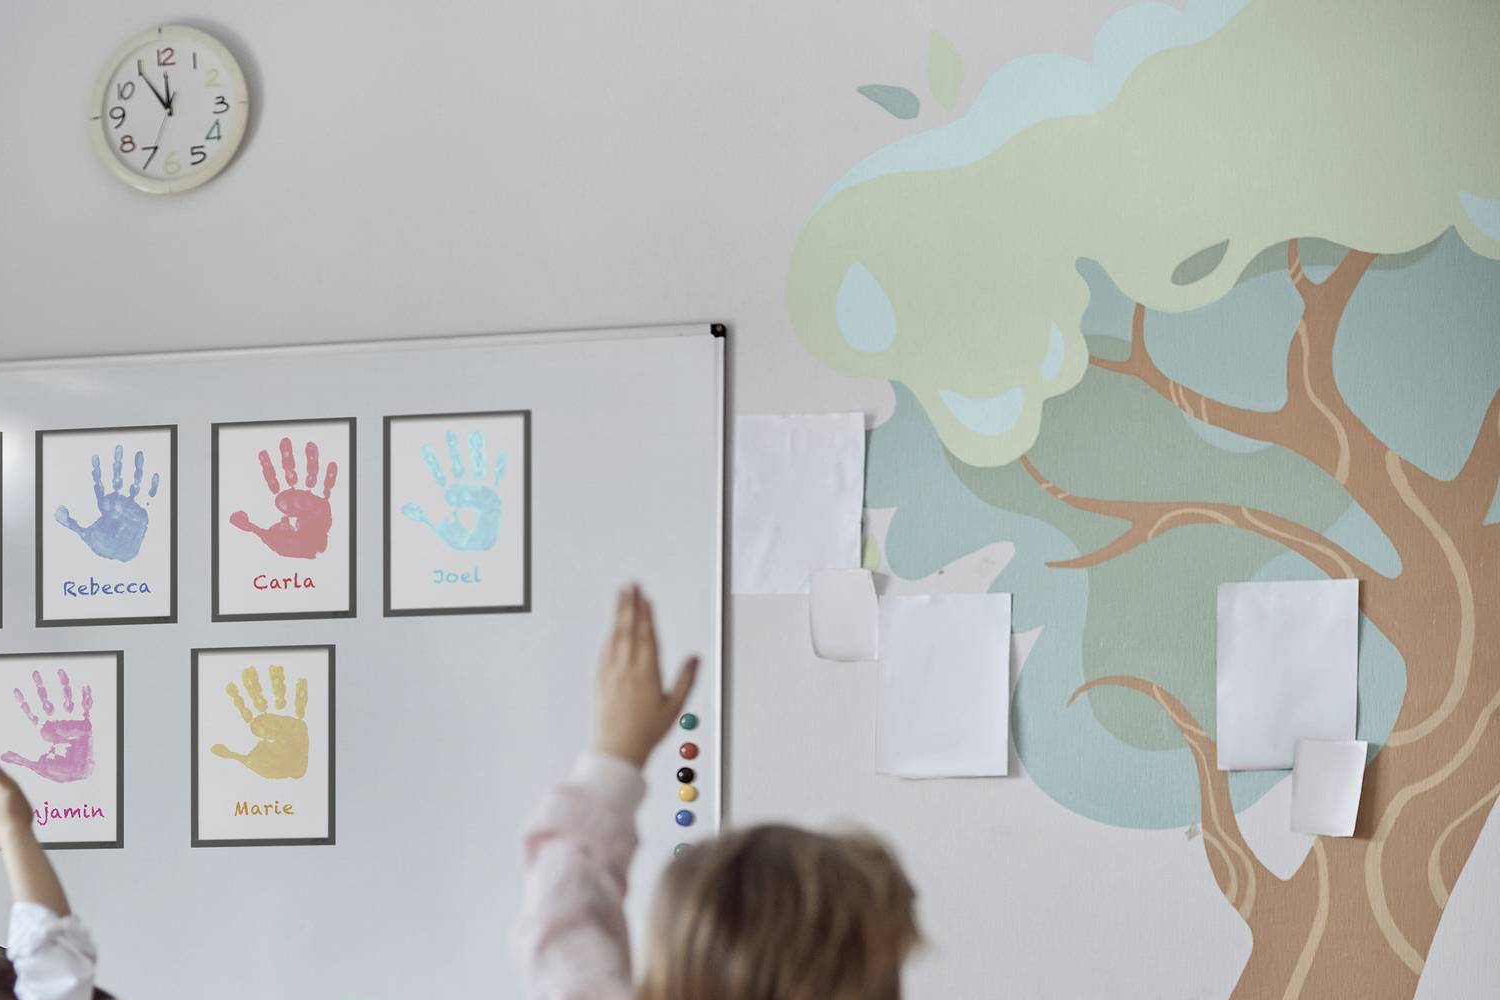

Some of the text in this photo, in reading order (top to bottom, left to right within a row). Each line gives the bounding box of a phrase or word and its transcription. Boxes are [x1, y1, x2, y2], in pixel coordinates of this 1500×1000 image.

[156, 47, 176, 67] 12
[192, 52, 198, 69] 1
[116, 81, 136, 101] 10
[212, 96, 230, 114] 3
[109, 106, 126, 129] 9
[205, 119, 222, 141] 4
[120, 135, 136, 153] 8
[141, 145, 158, 170] 7
[190, 145, 207, 165] 5
[252, 571, 316, 592] Carla
[433, 567, 482, 585] Joel
[63, 576, 153, 598] Rebecca
[32, 800, 105, 826] njamin
[234, 800, 295, 817] Marie
